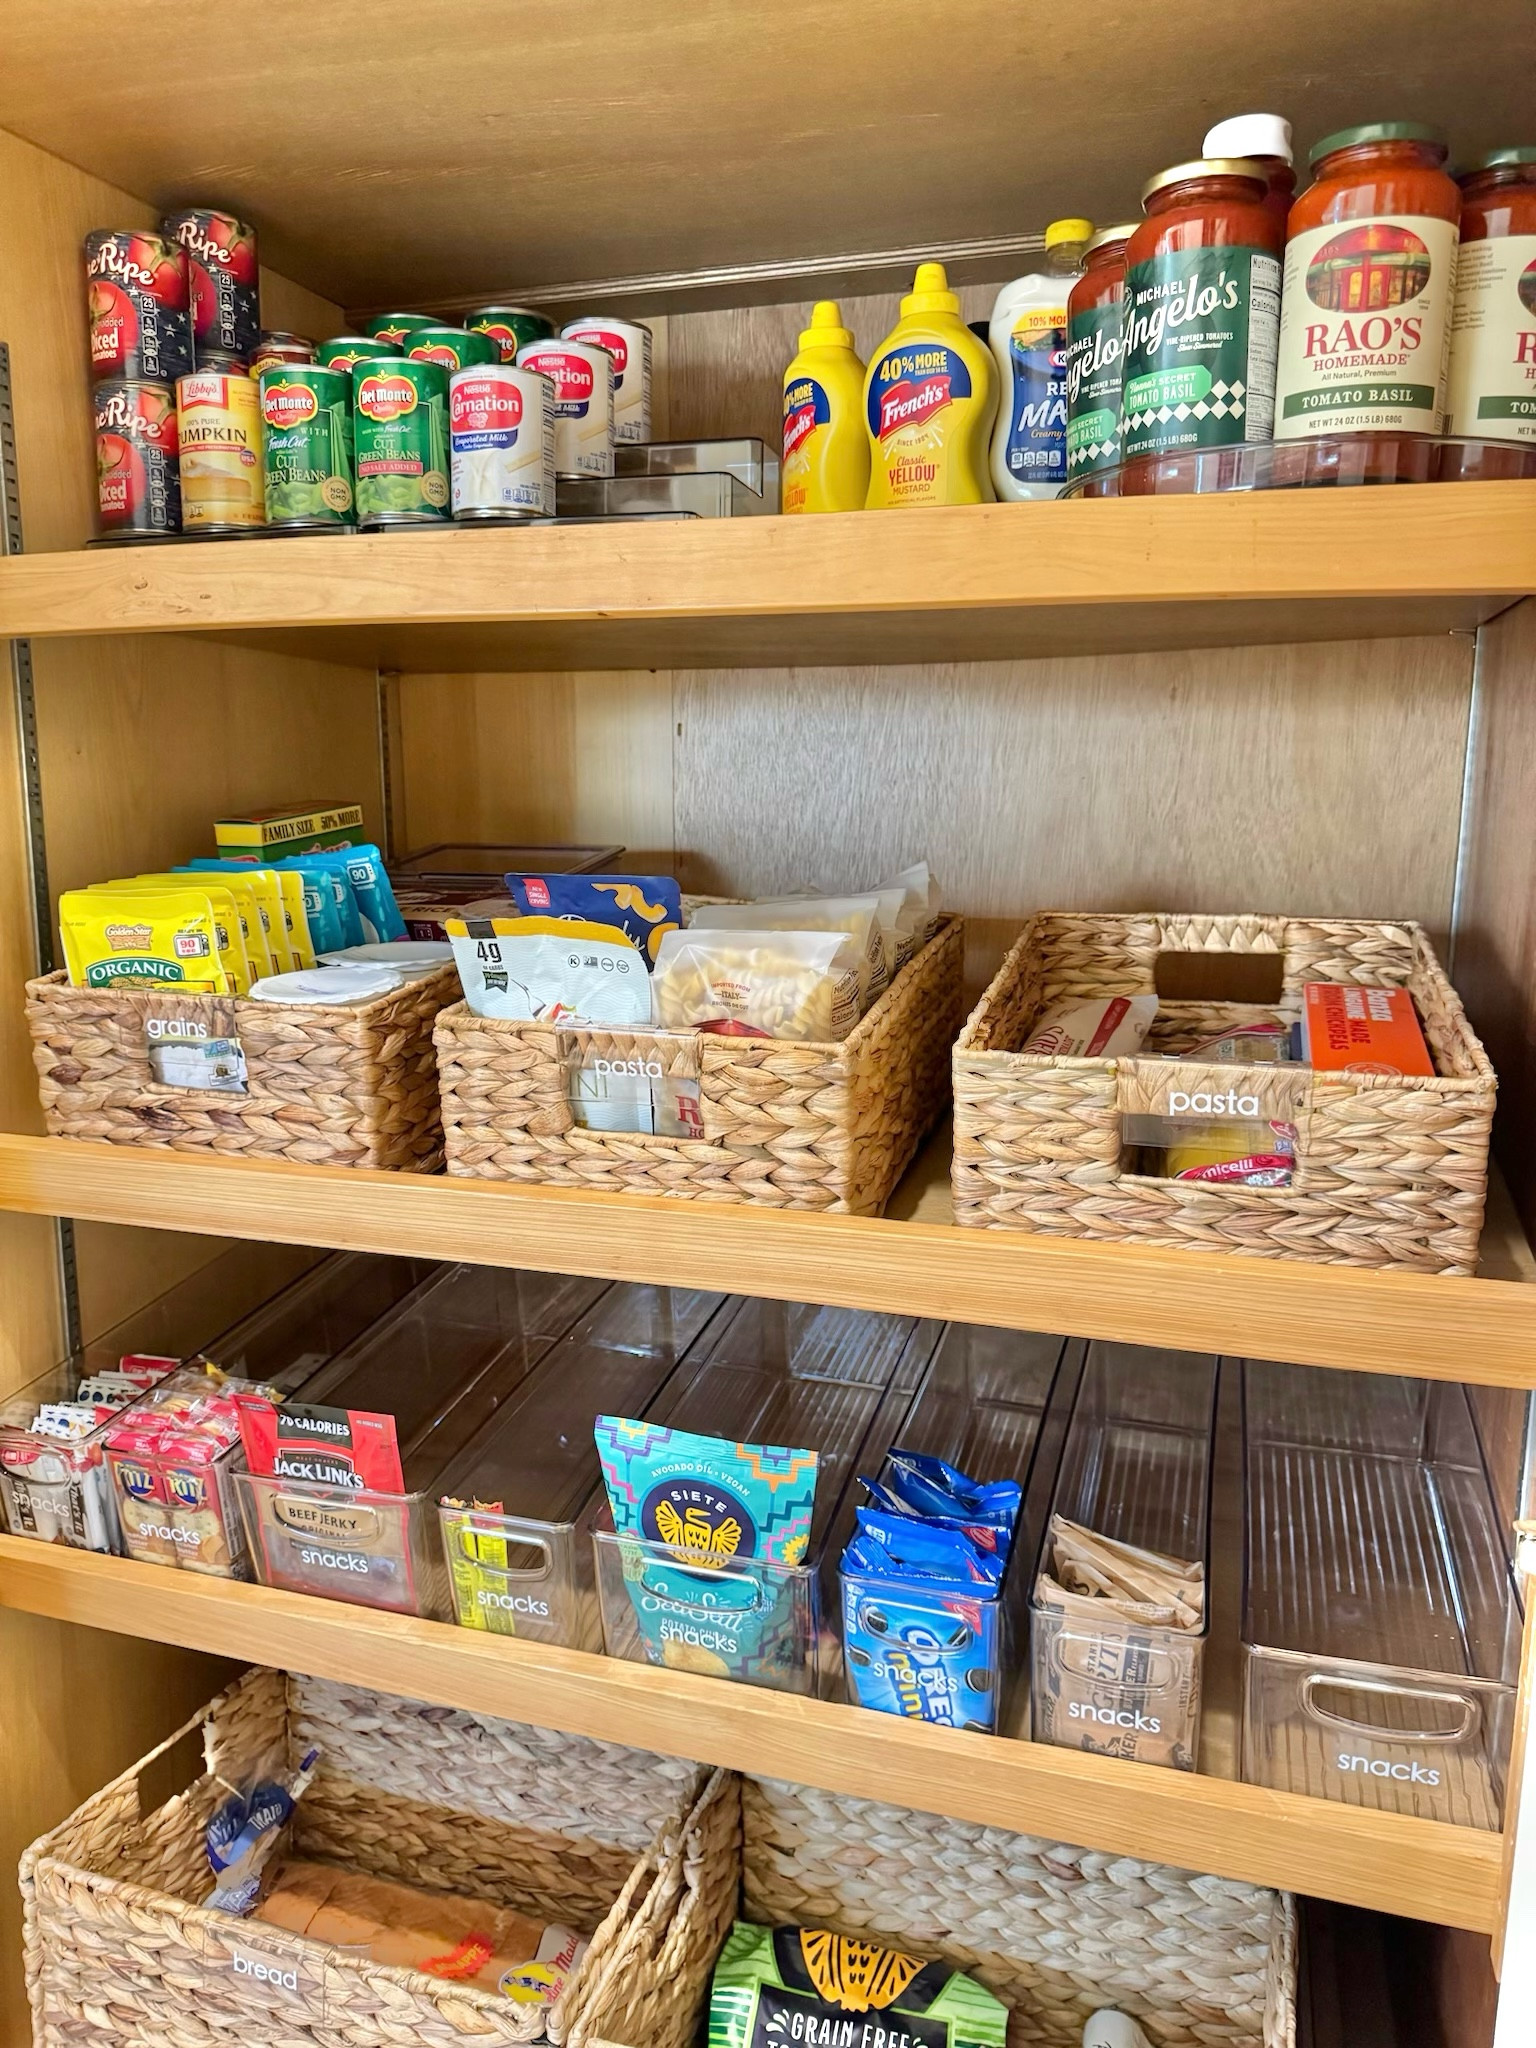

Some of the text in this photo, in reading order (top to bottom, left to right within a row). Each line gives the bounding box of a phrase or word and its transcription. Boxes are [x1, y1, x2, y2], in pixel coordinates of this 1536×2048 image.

[179, 221, 231, 263] Ripe
[99, 242, 153, 286] Ripe
[1136, 280, 1186, 306] MICHAEL
[1121, 270, 1239, 357] Angelo's
[1251, 298, 1276, 313] Calories
[1029, 316, 1046, 327] 10%
[1303, 316, 1422, 360] RAO'S
[880, 351, 947, 382] 40% MORE
[1313, 353, 1407, 373] HOMEMADE
[1158, 372, 1197, 385] SECRET
[1321, 368, 1397, 381] All Natural, Premium
[186, 378, 217, 397] Libby's
[361, 388, 413, 404] Del Monte
[1046, 381, 1067, 396] RE
[1129, 382, 1196, 409] TOMATO BASIL
[1302, 388, 1414, 409] TOMATO BASIL
[278, 397, 313, 411] Monte
[453, 393, 520, 423] Carnation
[882, 384, 944, 429] French's
[1510, 402, 1536, 414] TOM
[107, 396, 161, 438] Ripe
[1018, 399, 1067, 432] MA
[1077, 415, 1104, 430] SECRET
[1308, 420, 1321, 429] NET
[1323, 420, 1333, 429] WT
[1335, 418, 1344, 428] 24
[1346, 417, 1356, 427] OZ
[373, 438, 396, 449] CUT
[489, 433, 509, 442] Milk
[1031, 429, 1062, 441] Creamy
[1080, 426, 1103, 442] BASIL
[276, 454, 298, 469] CUT
[359, 448, 421, 464] GREEN BEANS
[896, 455, 927, 468] Classic
[289, 468, 327, 483] BEANS
[369, 464, 387, 472] SALT
[388, 463, 417, 472] ADDED
[889, 464, 936, 487] YELLOW
[330, 487, 346, 495] NON
[428, 482, 444, 490] NON
[892, 483, 931, 496] MUSTARD
[331, 494, 346, 502] GMO
[263, 822, 297, 843] FAMILY
[296, 818, 316, 835] SIZE
[338, 808, 361, 826] MORE
[351, 868, 366, 881] 90
[106, 926, 152, 937] Golden Star
[180, 938, 196, 949] 90
[477, 941, 502, 963] 4g
[91, 961, 179, 981] ORGANIC
[721, 990, 741, 1000] ITALY
[147, 1017, 207, 1039] grains
[1325, 1006, 1350, 1051] CHICKPEAS
[1350, 1020, 1371, 1045] MADE
[594, 1057, 663, 1081] pasta
[1169, 1088, 1259, 1117] pasta
[1200, 1158, 1253, 1180] micelli
[279, 1413, 350, 1437] 70 CALORIES
[273, 1456, 364, 1489] JACK LINK'S
[651, 1462, 750, 1498] AVOCADO OIL VEGAN
[11, 1491, 70, 1518] snacks
[670, 1490, 728, 1514] SIETE
[288, 1507, 357, 1530] BEEF JERKY
[139, 1522, 201, 1545] snacks
[301, 1550, 369, 1574] snacks
[477, 1590, 549, 1617] snacks
[659, 1624, 738, 1654] snacks
[873, 1662, 959, 1692] snacks
[1068, 1702, 1161, 1733] snacks
[1337, 1753, 1441, 1787] snacks
[232, 1952, 298, 1992] bread
[790, 2012, 911, 2048] GRAIN FREE
